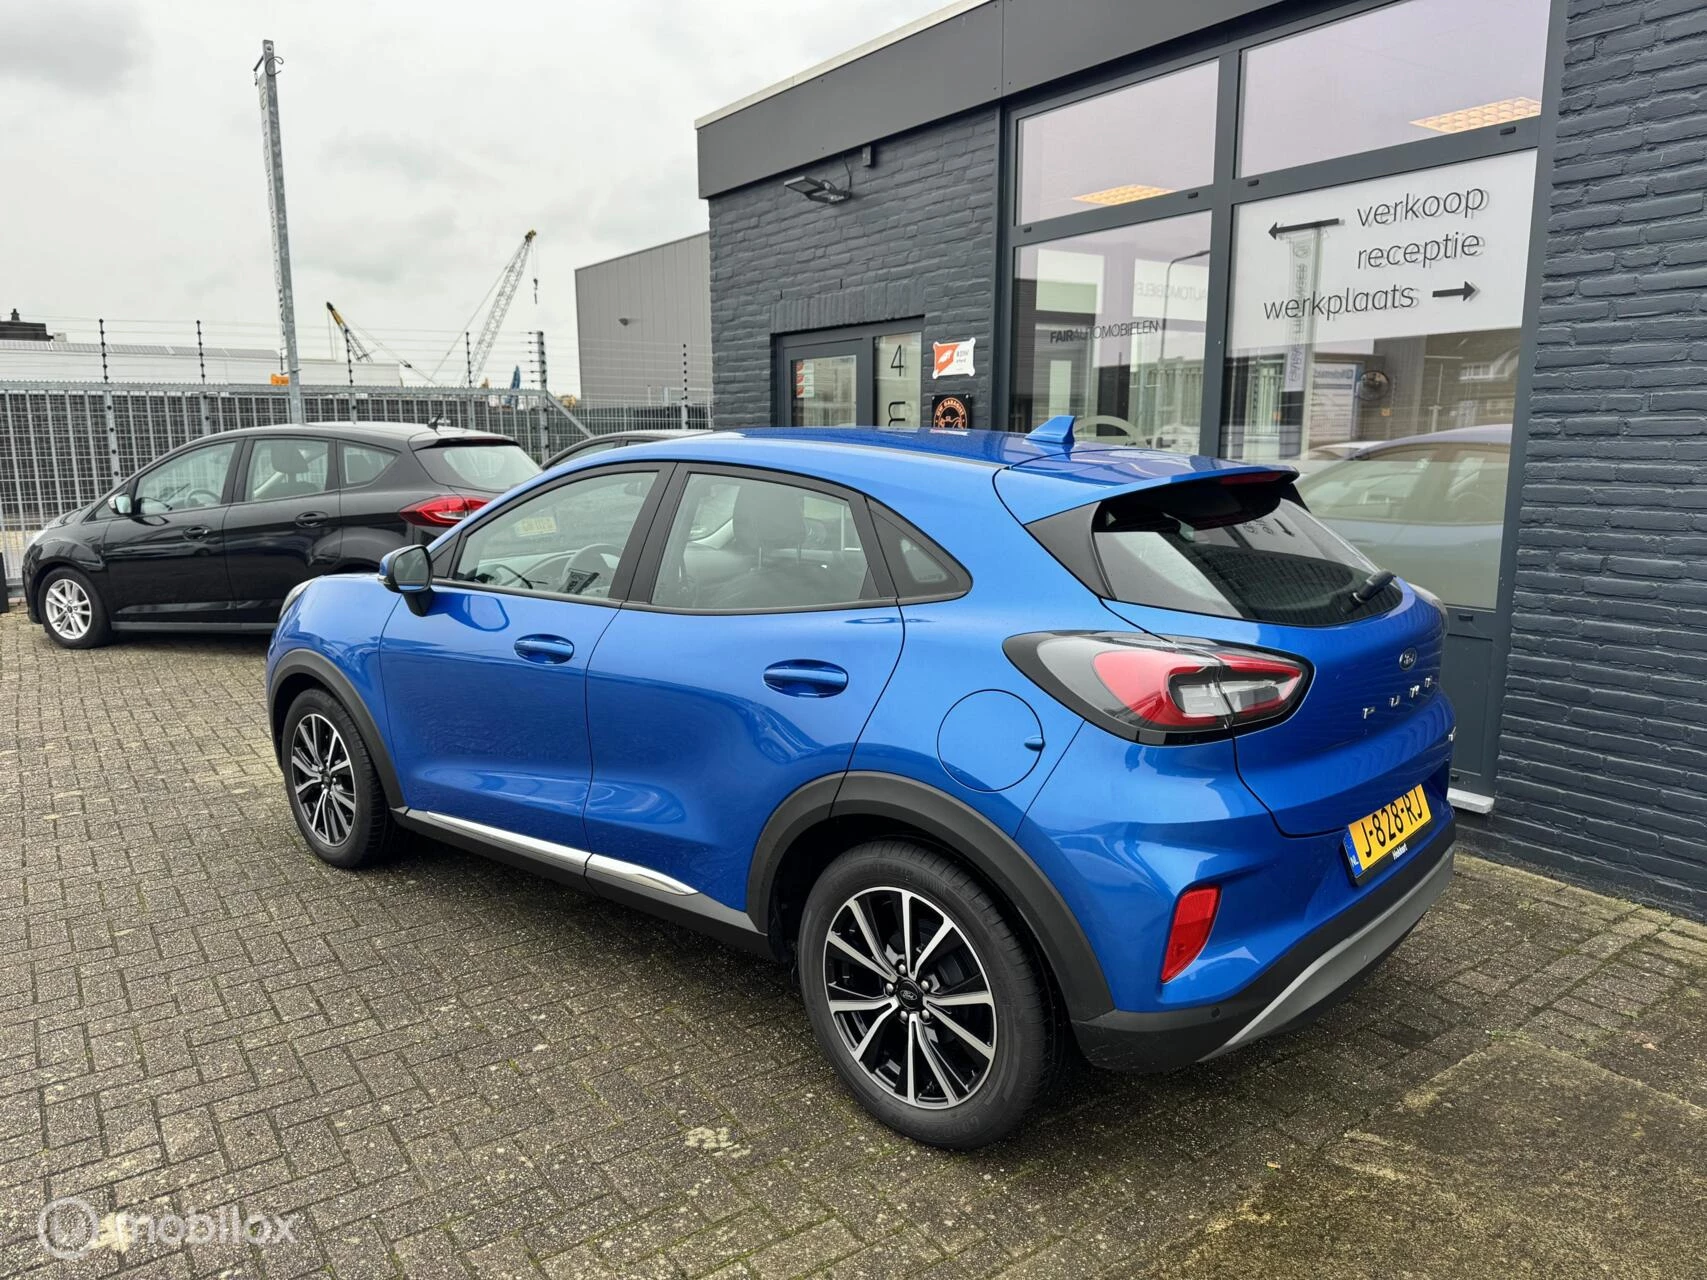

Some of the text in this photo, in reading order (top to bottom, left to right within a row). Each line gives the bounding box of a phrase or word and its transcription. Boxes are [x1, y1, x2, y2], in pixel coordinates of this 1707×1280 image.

[1357, 188, 1485, 227] verkoop
[1357, 231, 1480, 269] receptie
[1263, 284, 1415, 321] werkplaats
[890, 344, 904, 376] 4
[1360, 788, 1423, 858] J-828-RJ
